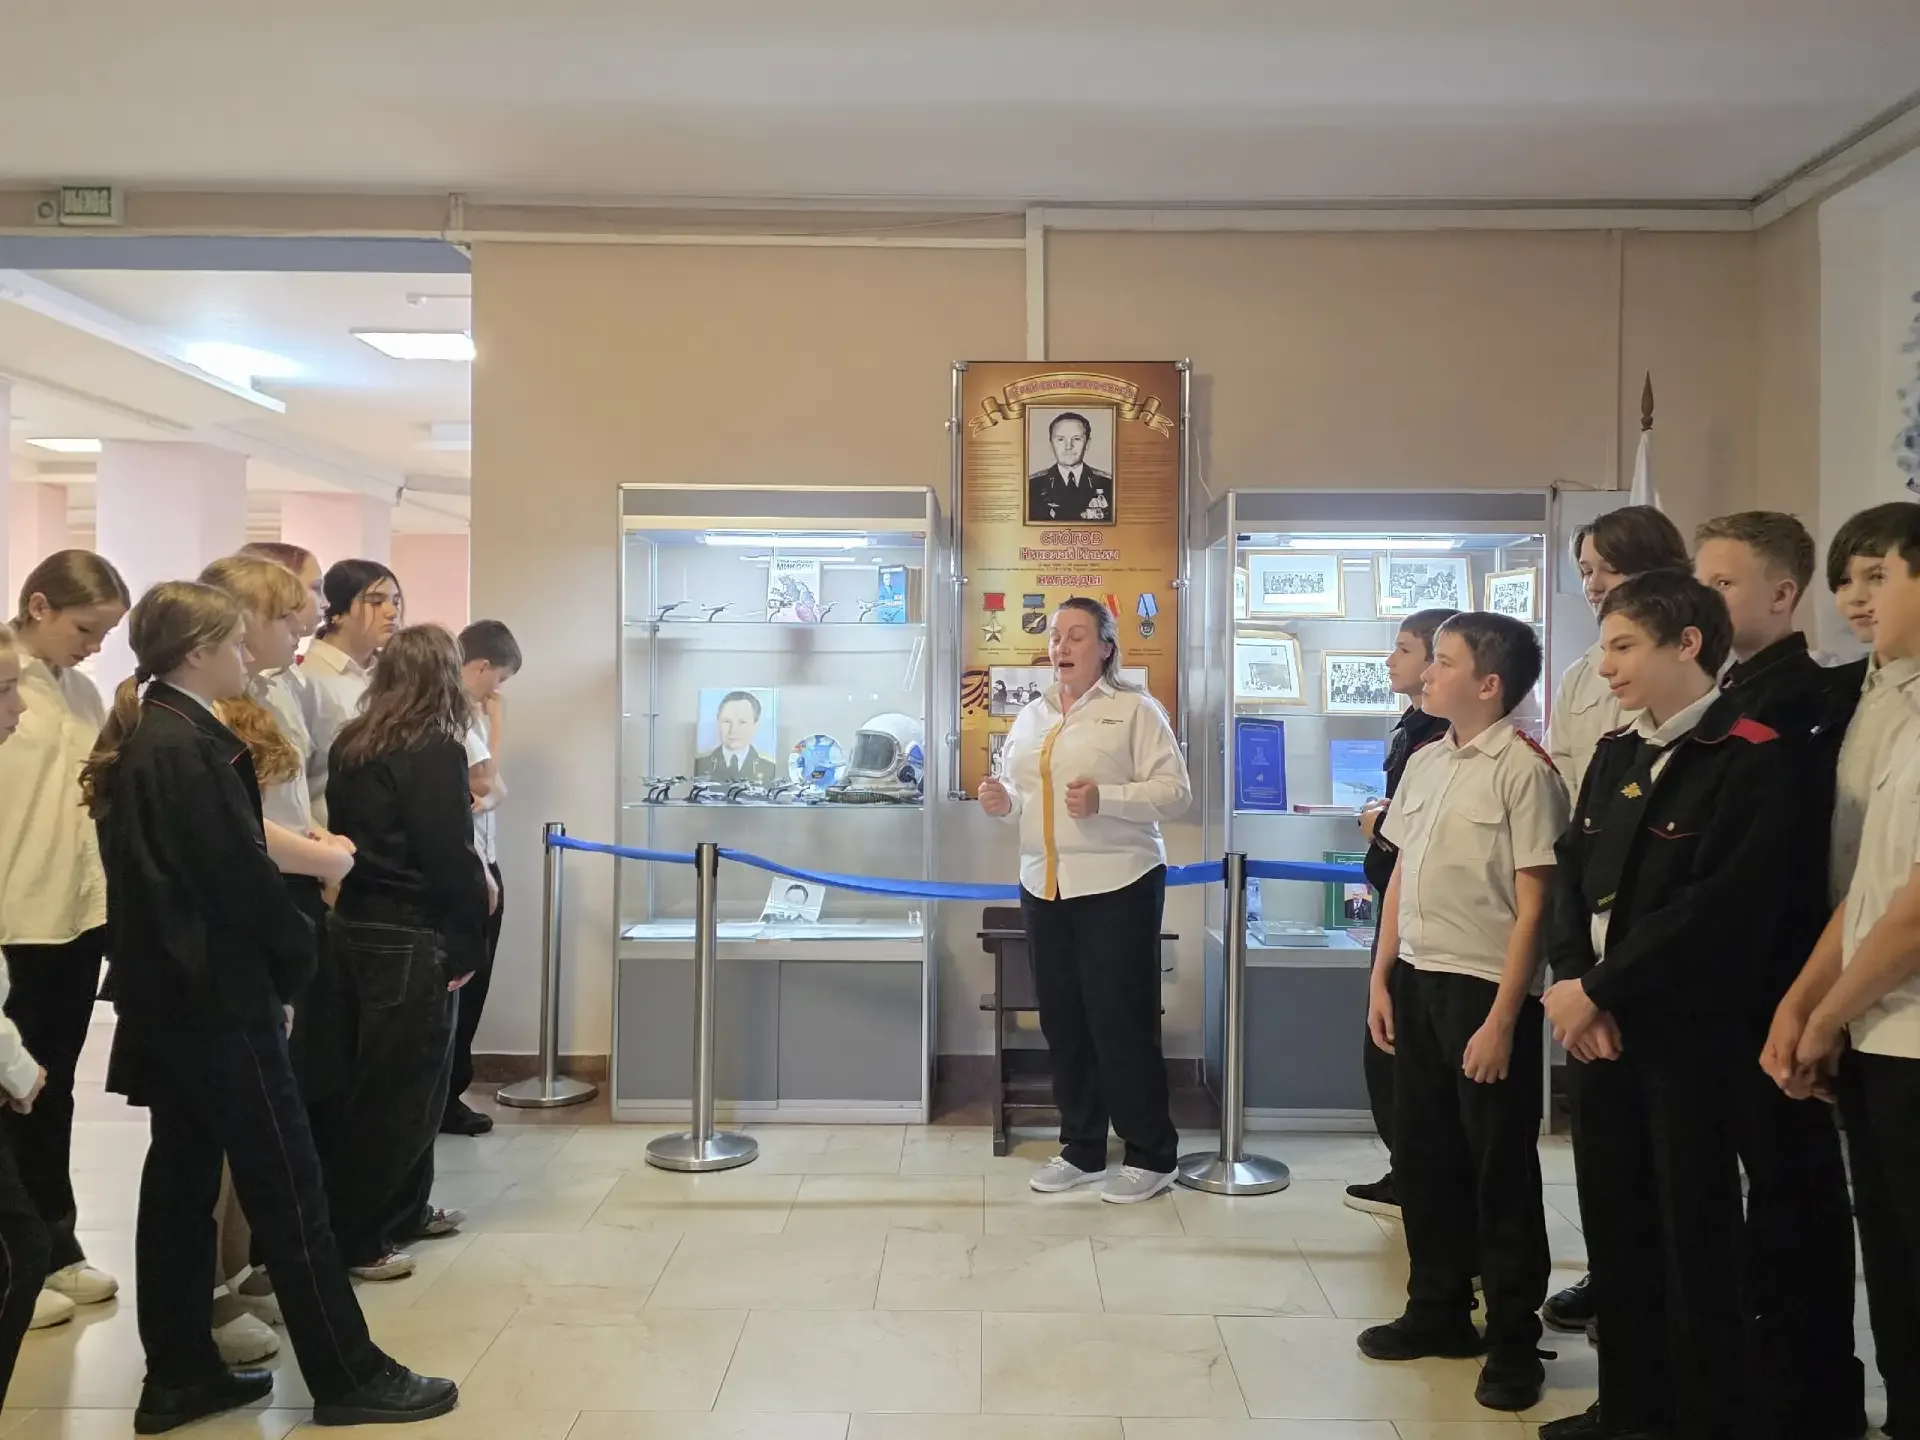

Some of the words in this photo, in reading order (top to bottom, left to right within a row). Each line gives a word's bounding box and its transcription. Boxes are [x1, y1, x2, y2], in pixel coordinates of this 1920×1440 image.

[1020, 547, 1075, 560] Николай
[1076, 547, 1120, 560] Ильич
[1037, 575, 1102, 587] НАГРАДЫ
